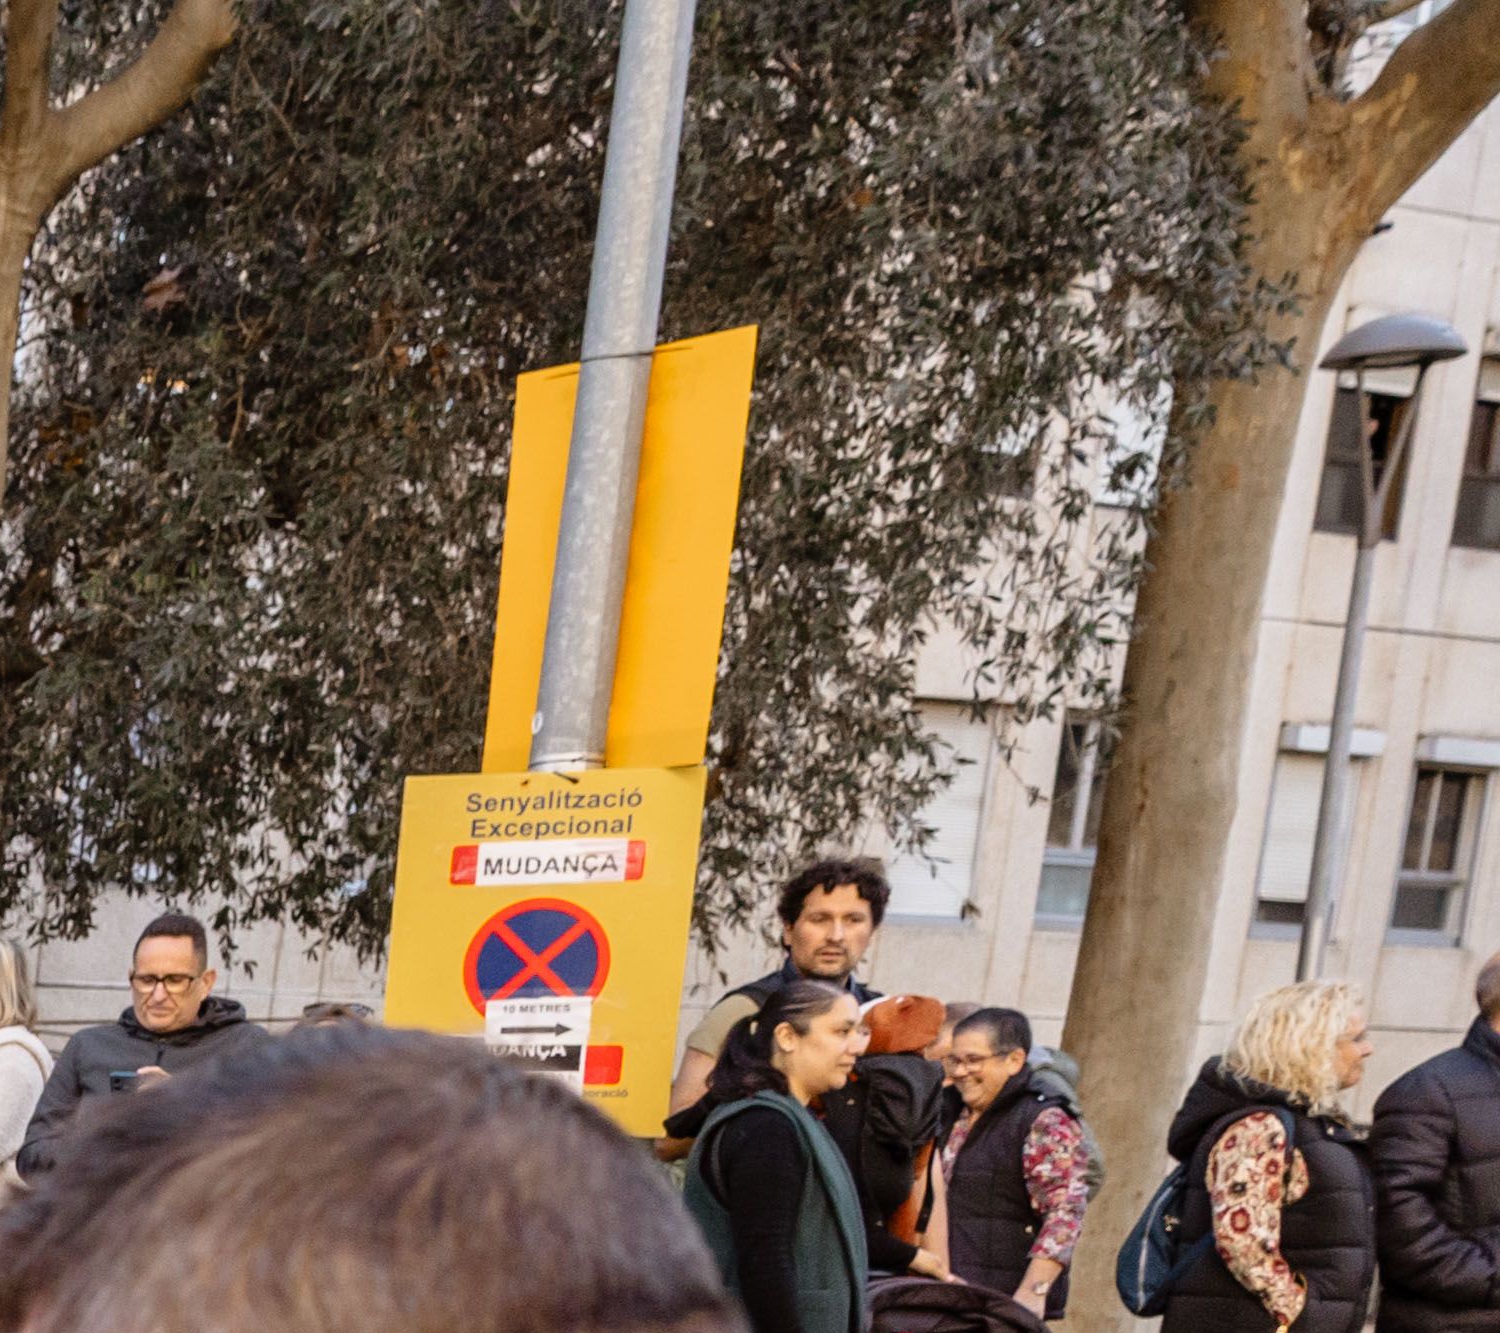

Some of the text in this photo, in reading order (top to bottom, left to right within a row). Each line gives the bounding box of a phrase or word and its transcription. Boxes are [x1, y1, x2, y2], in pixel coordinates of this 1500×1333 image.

[466, 787, 643, 816] Senyalització
[470, 814, 633, 840] Excepcional
[483, 853, 618, 879] MUDANÇA
[519, 1004, 572, 1014] METRES
[490, 1044, 567, 1061] DANÇA
